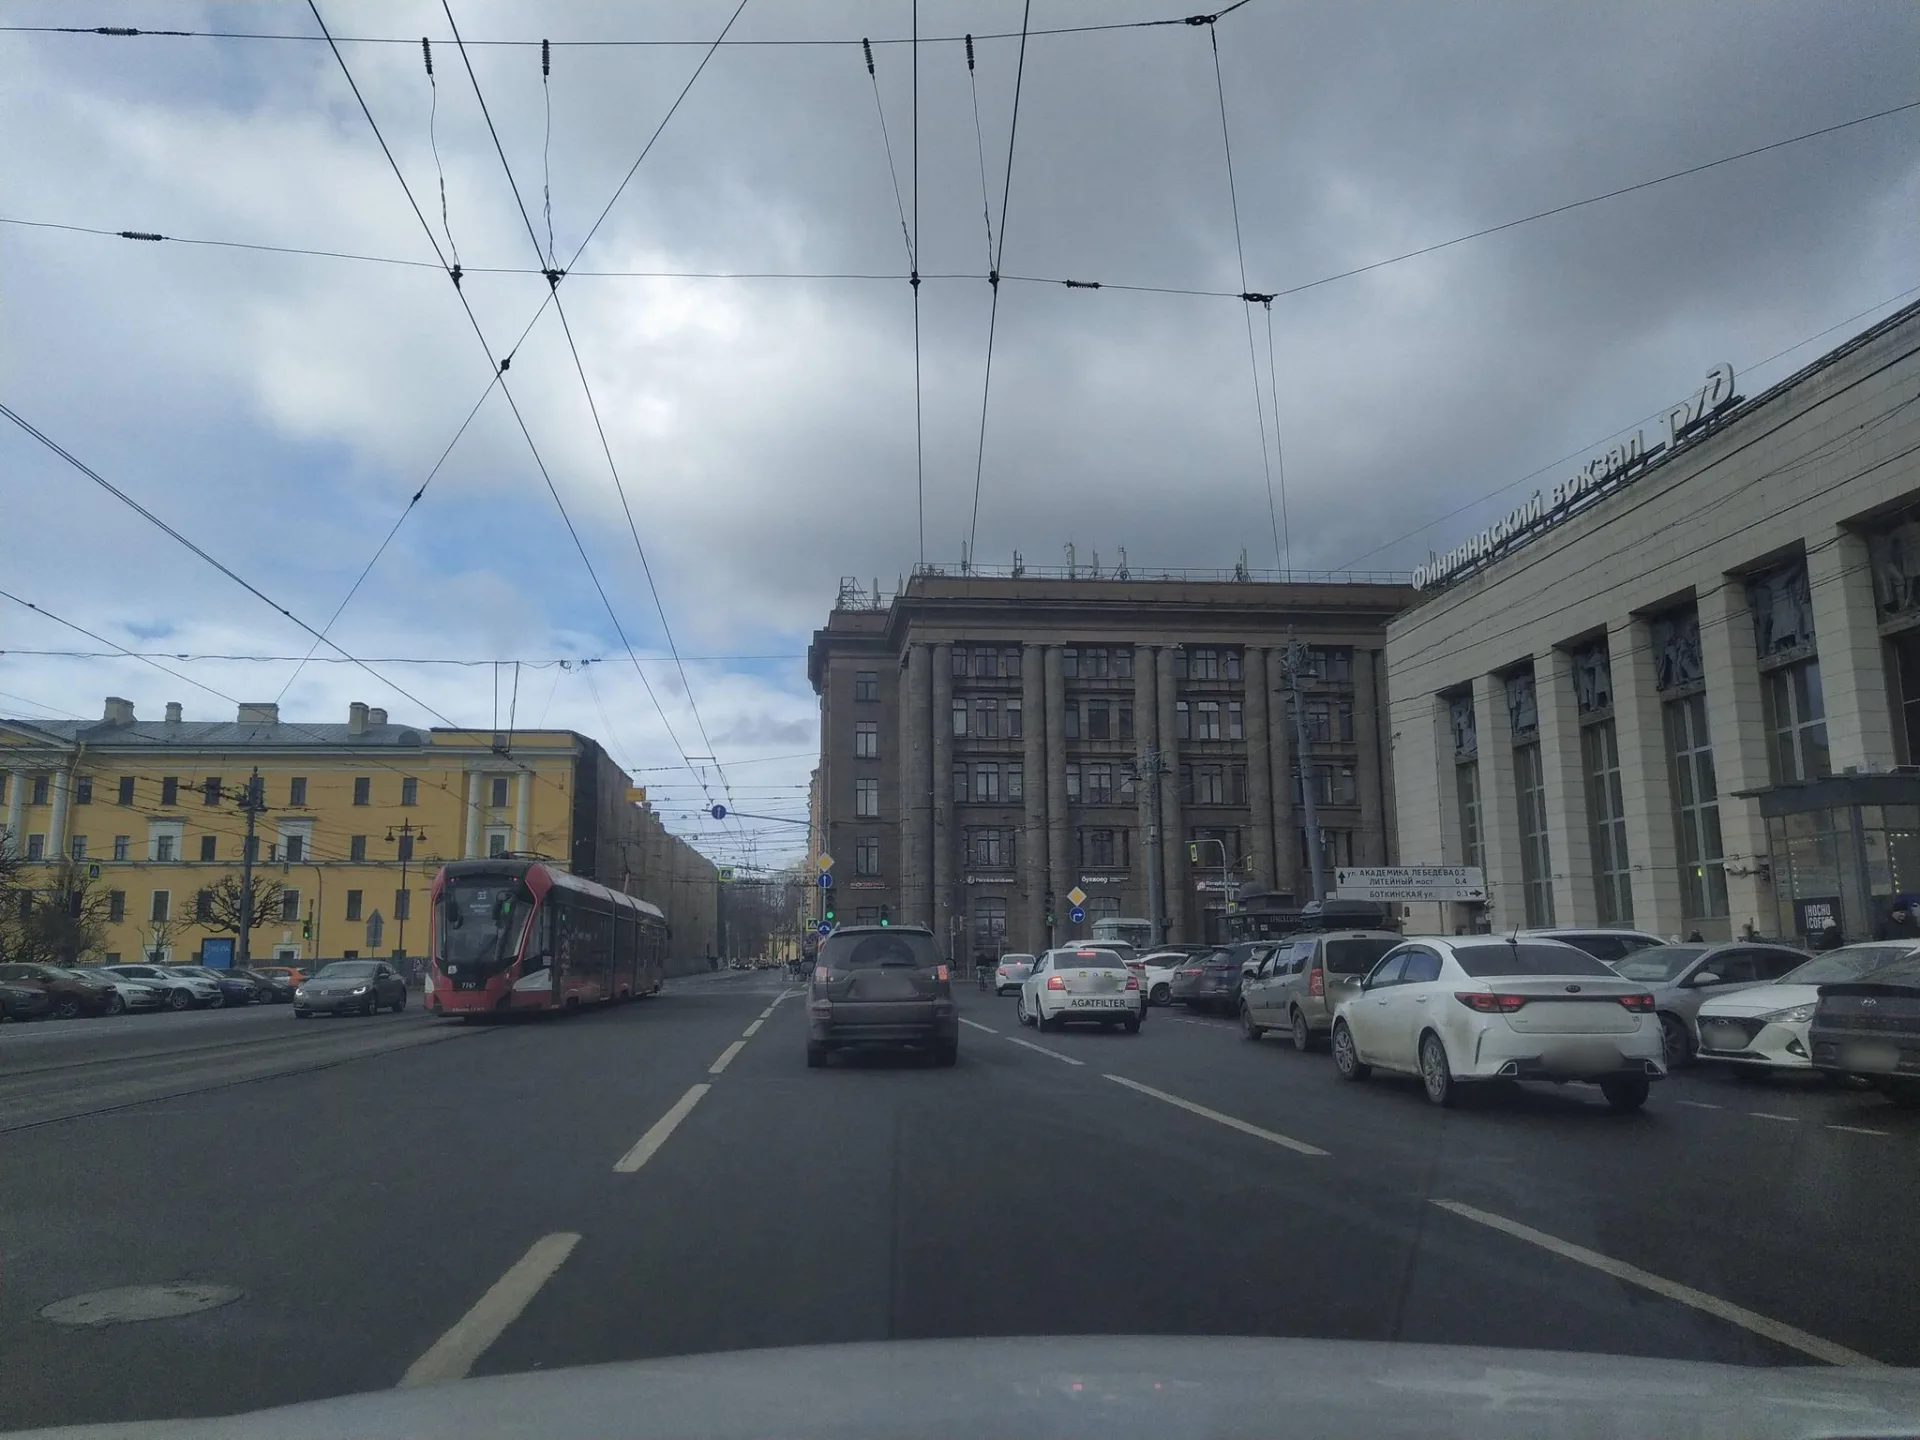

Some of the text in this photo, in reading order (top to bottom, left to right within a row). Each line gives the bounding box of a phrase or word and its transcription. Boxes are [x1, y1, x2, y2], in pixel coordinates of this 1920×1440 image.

[1360, 869, 1409, 877] АКАДЕМИКА
[1412, 869, 1454, 877] ЛЕБЕДЕВА
[1370, 877, 1413, 885] ЛИТЕЙНЫЙ
[1370, 890, 1422, 898] БОТКИНСКАЯ
[1807, 904, 1831, 916] HOCHU
[1809, 916, 1834, 929] COF
[1071, 999, 1126, 1008] AGATFILTER
